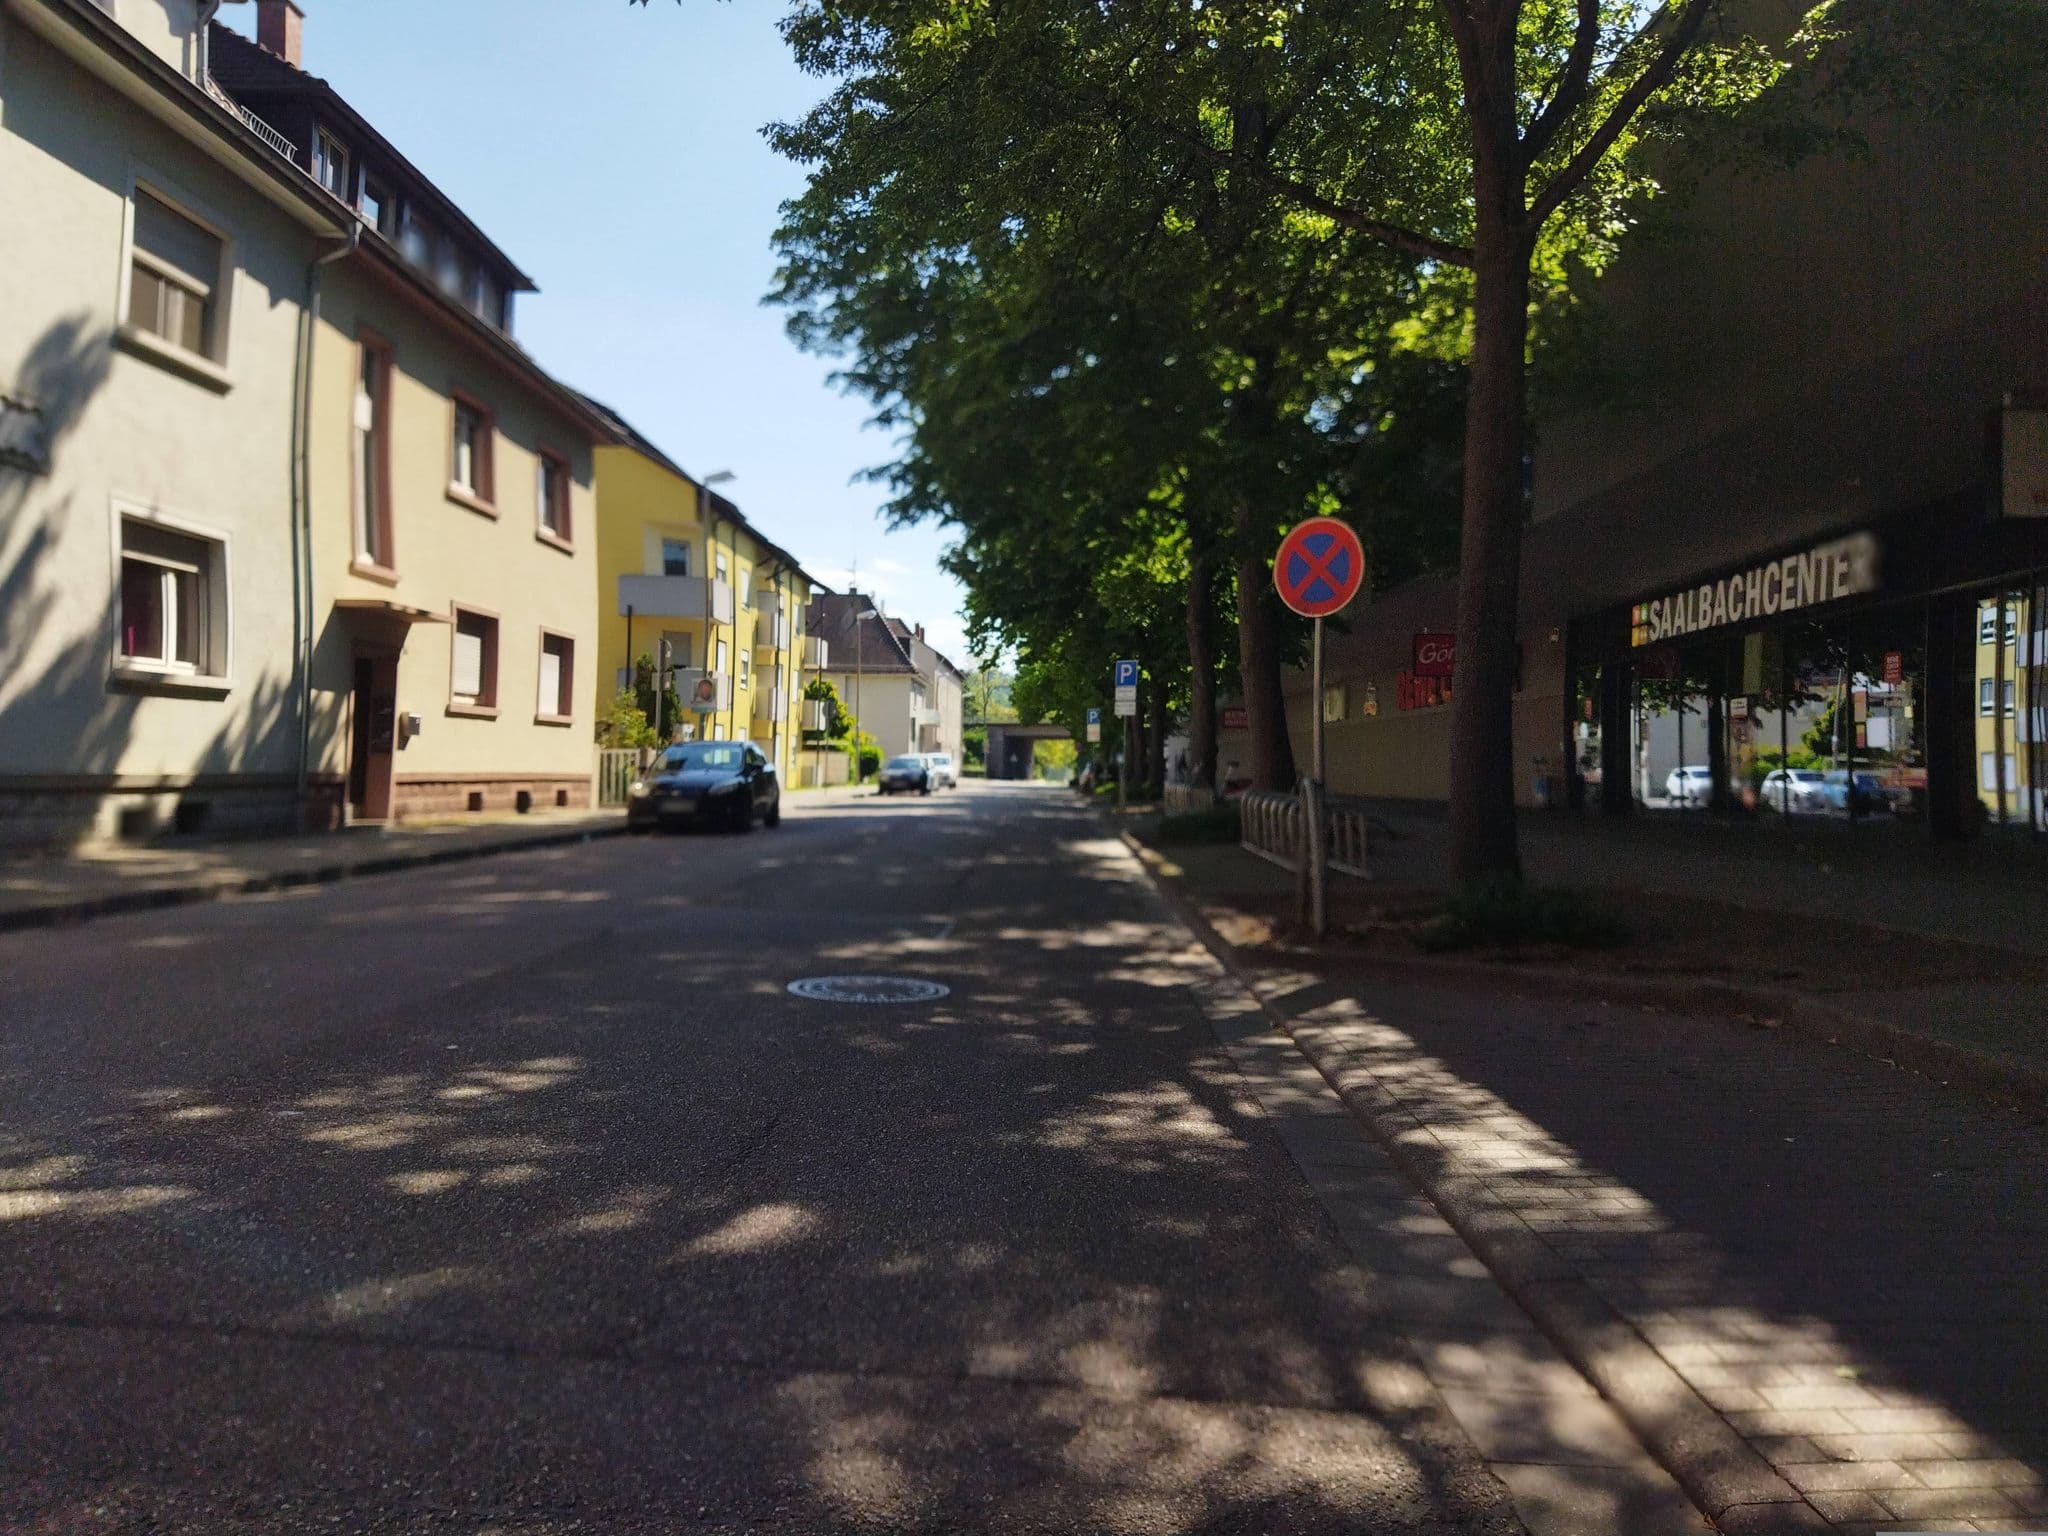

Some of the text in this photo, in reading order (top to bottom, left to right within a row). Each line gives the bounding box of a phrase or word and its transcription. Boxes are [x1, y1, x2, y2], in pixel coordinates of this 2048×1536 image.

[1649, 539, 1874, 641] SAALBACHCENTE
[1121, 664, 1132, 684] P
[1090, 711, 1099, 723] P
